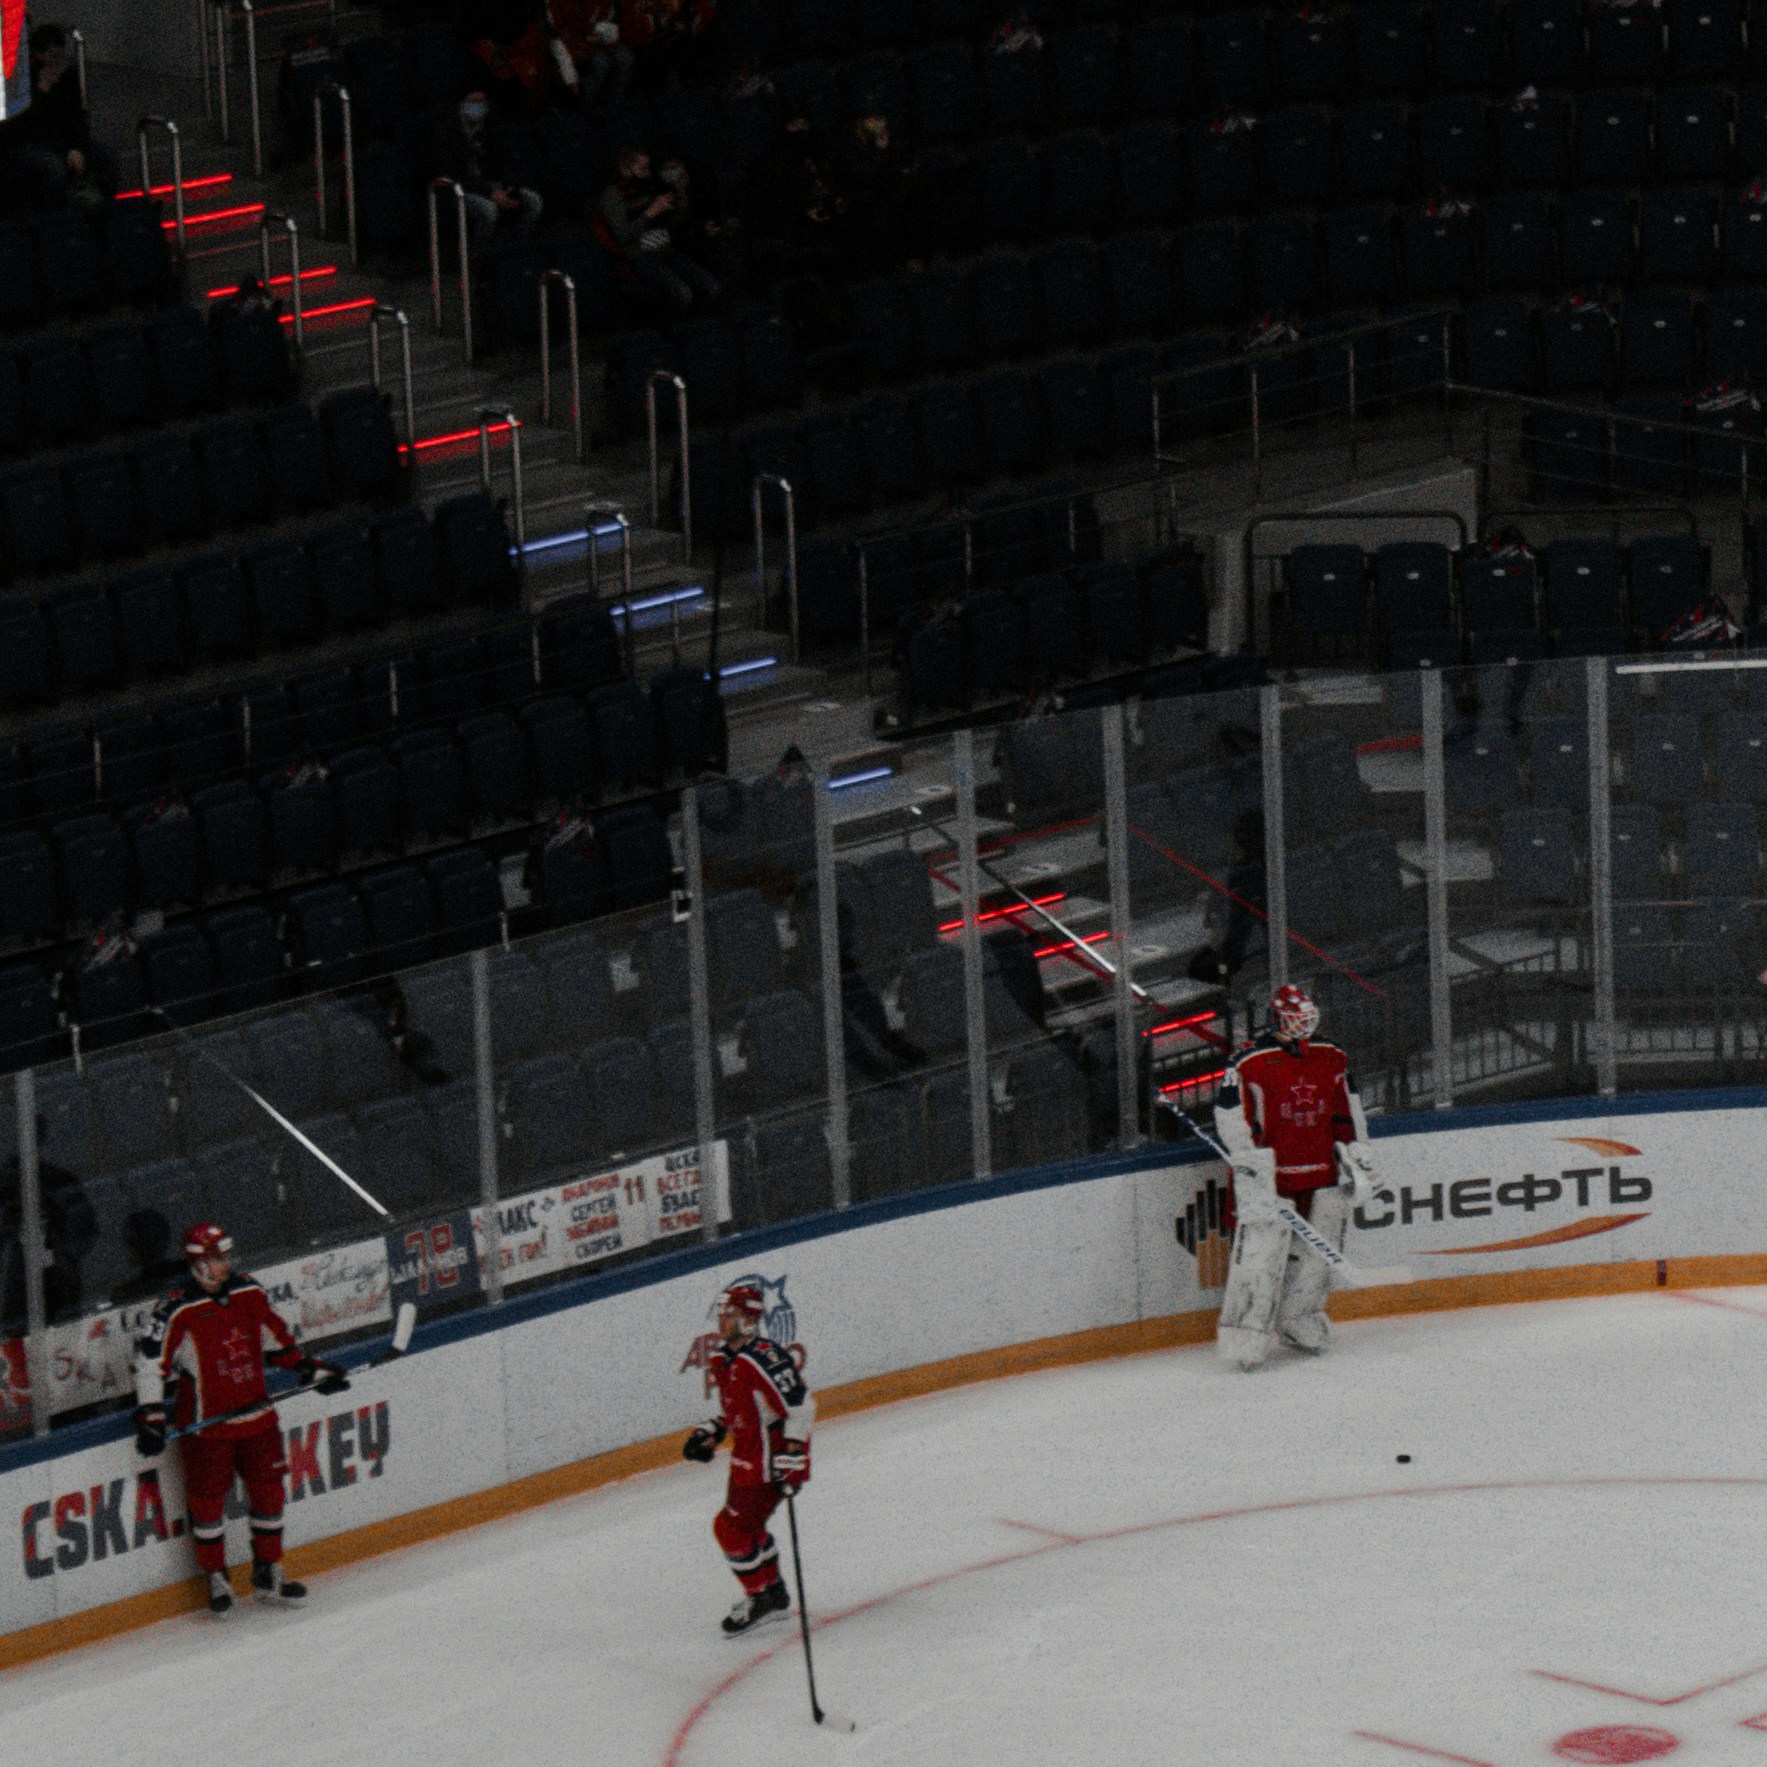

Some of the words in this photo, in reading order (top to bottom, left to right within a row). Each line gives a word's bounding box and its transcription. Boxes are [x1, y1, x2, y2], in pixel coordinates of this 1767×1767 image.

[1353, 1166, 1652, 1229] СНЕФТЬ
[405, 1223, 458, 1297] 78
[22, 1401, 390, 1580] CSKA.KEY
